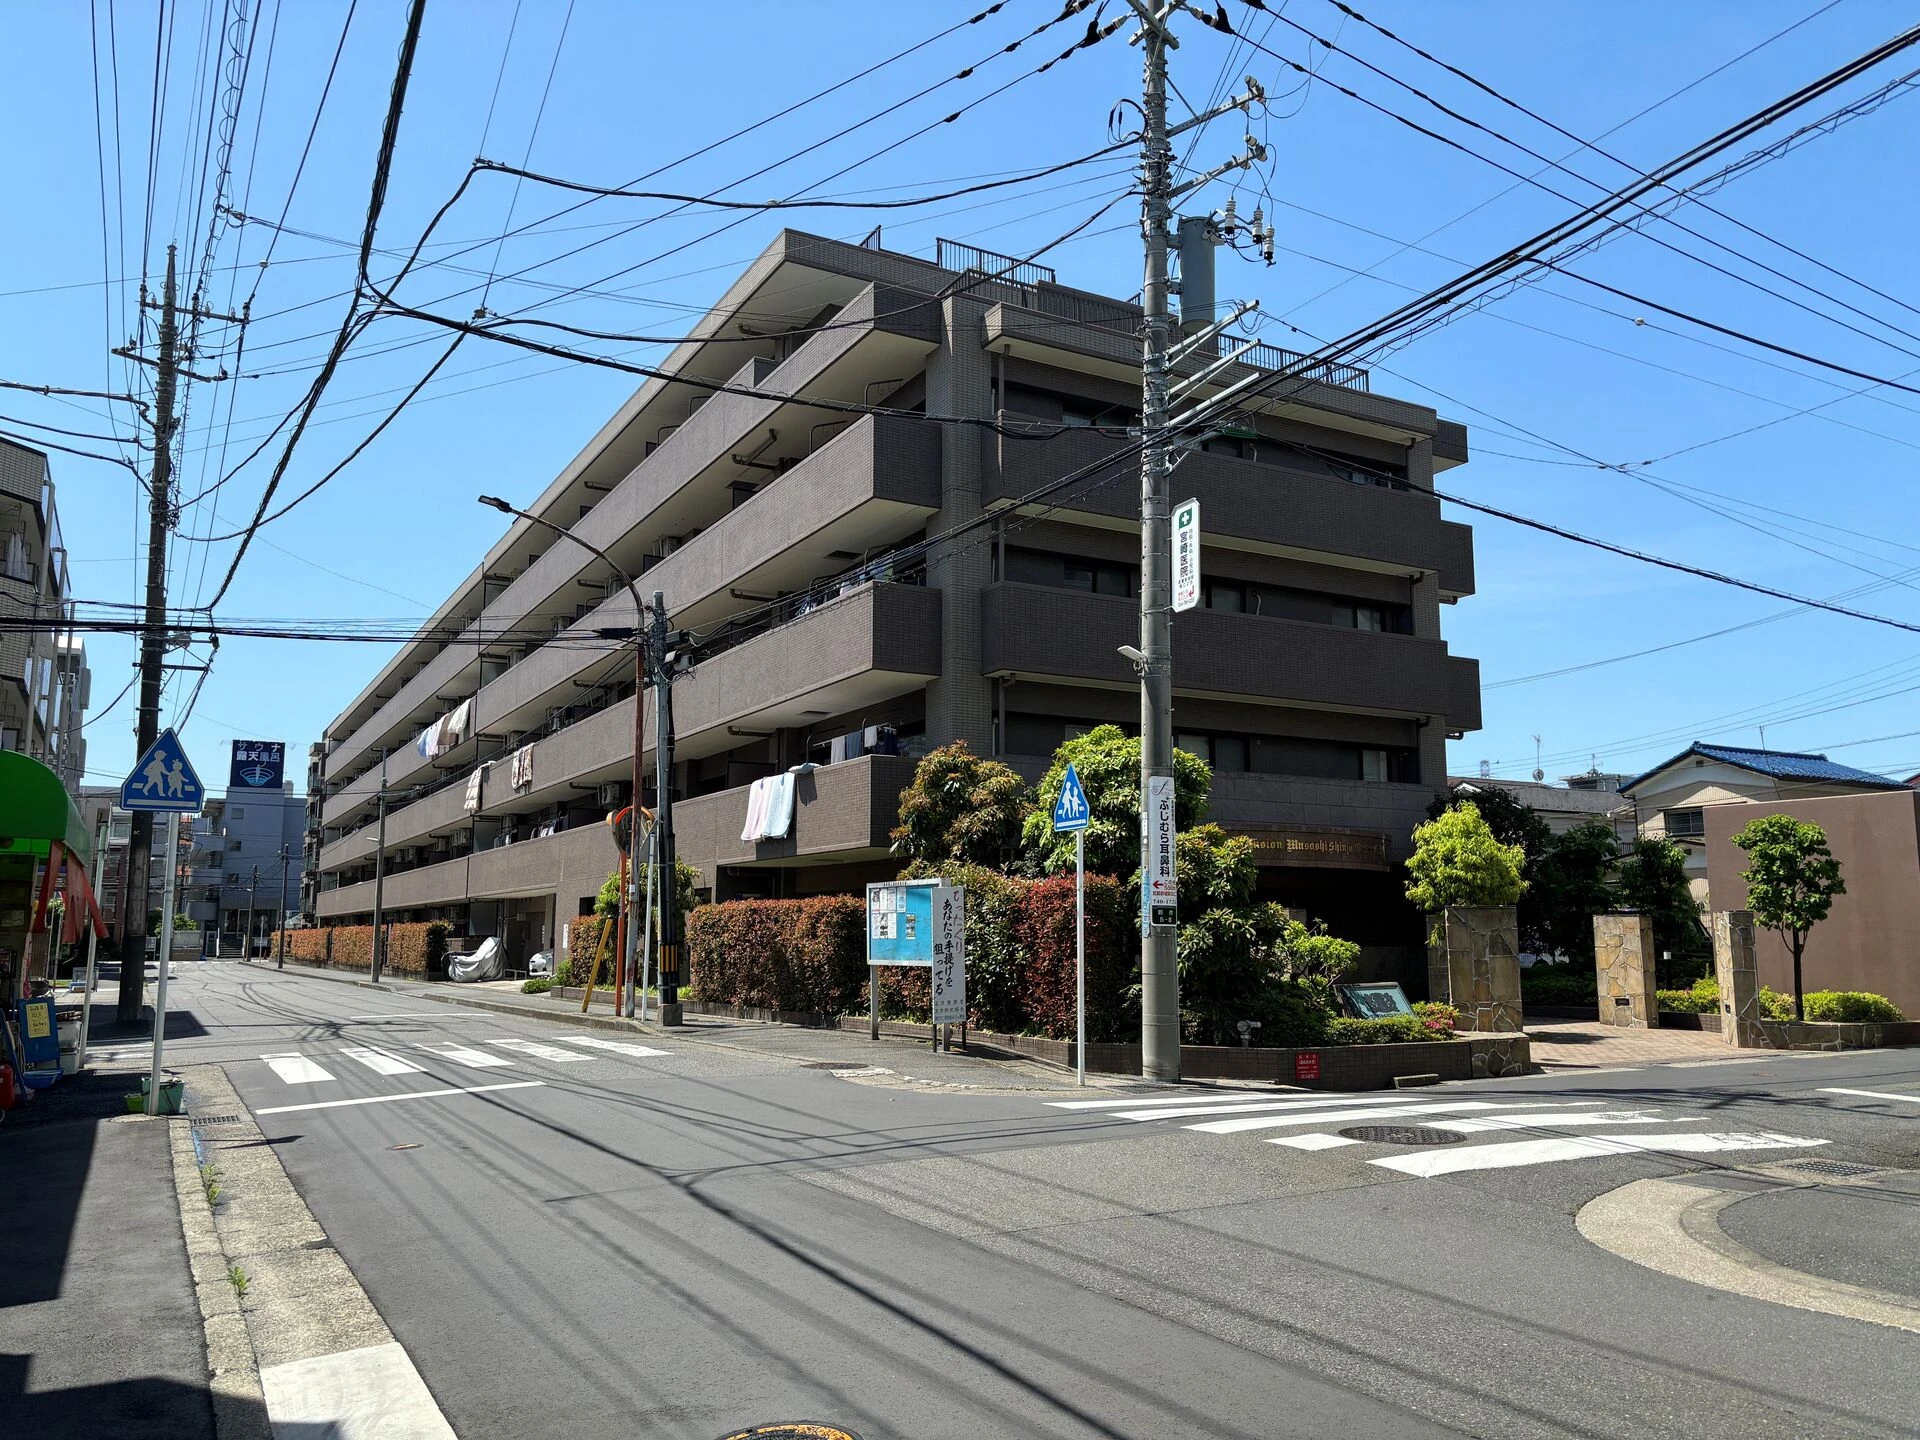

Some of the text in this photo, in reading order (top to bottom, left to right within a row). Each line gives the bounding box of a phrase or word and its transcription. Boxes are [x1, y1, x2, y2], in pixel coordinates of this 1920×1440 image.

[236, 750, 281, 762] 露天風呂
[237, 741, 281, 752] サウナ
[1159, 800, 1171, 877] ふじむら耳鼻科
[943, 898, 954, 988] あなたの手提げを
[953, 890, 963, 954] ひったくり
[933, 943, 944, 996] 狙ってる
